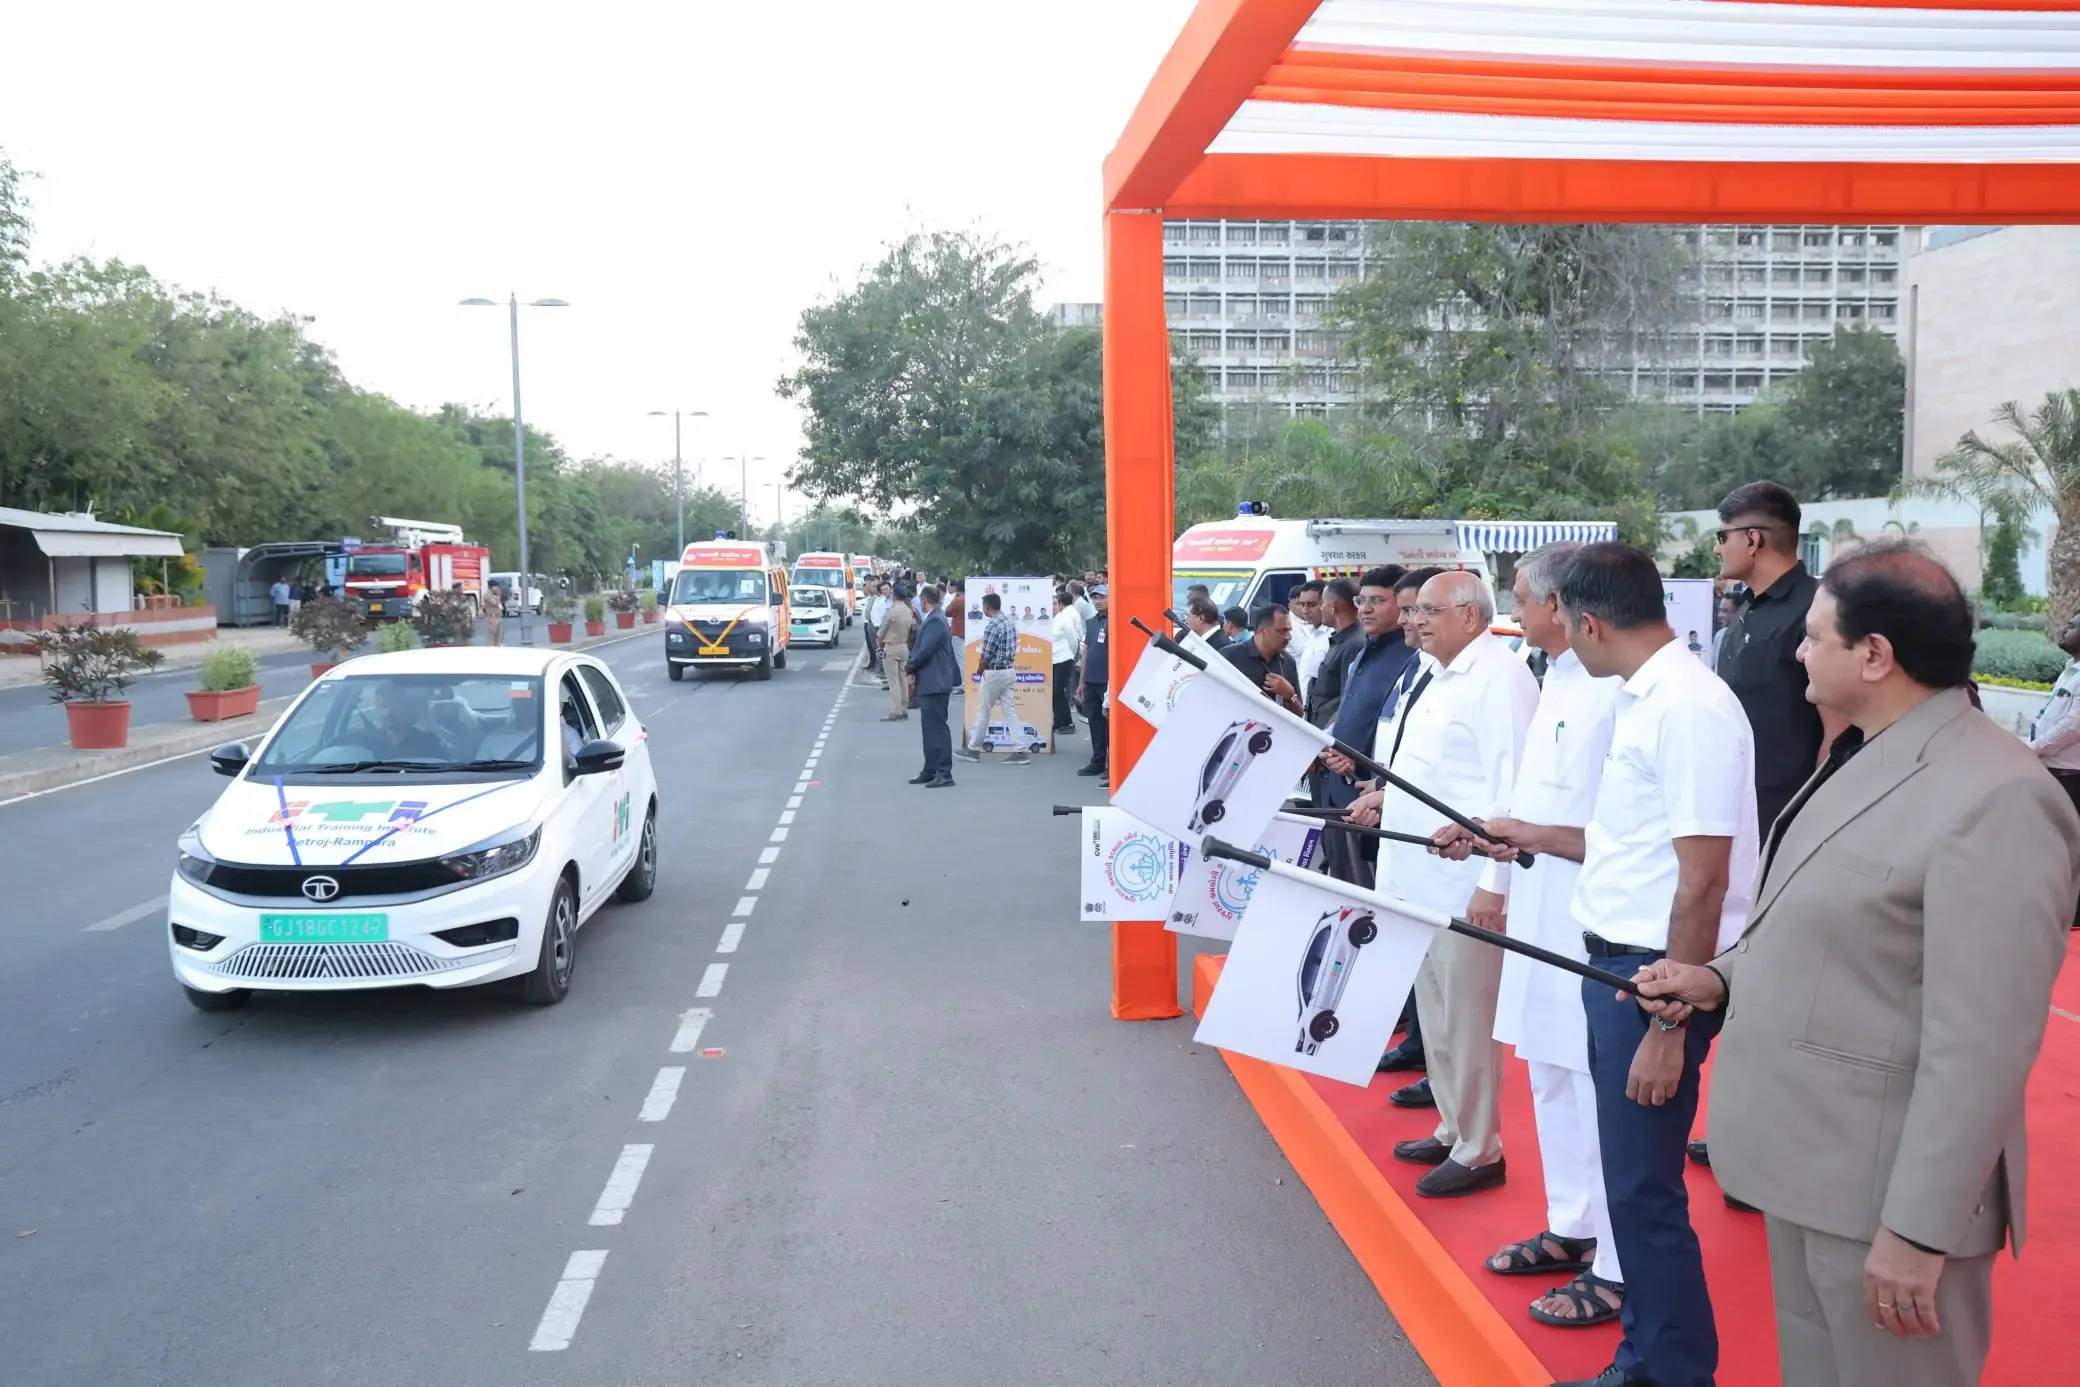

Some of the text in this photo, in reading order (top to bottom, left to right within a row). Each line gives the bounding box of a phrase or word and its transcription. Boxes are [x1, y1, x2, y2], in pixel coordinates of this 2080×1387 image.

[1320, 551, 1367, 562] ગુજરાત સરકાર
[245, 824, 313, 836] Indusial
[318, 823, 373, 833] Training
[286, 836, 396, 848] etroj-Rampra
